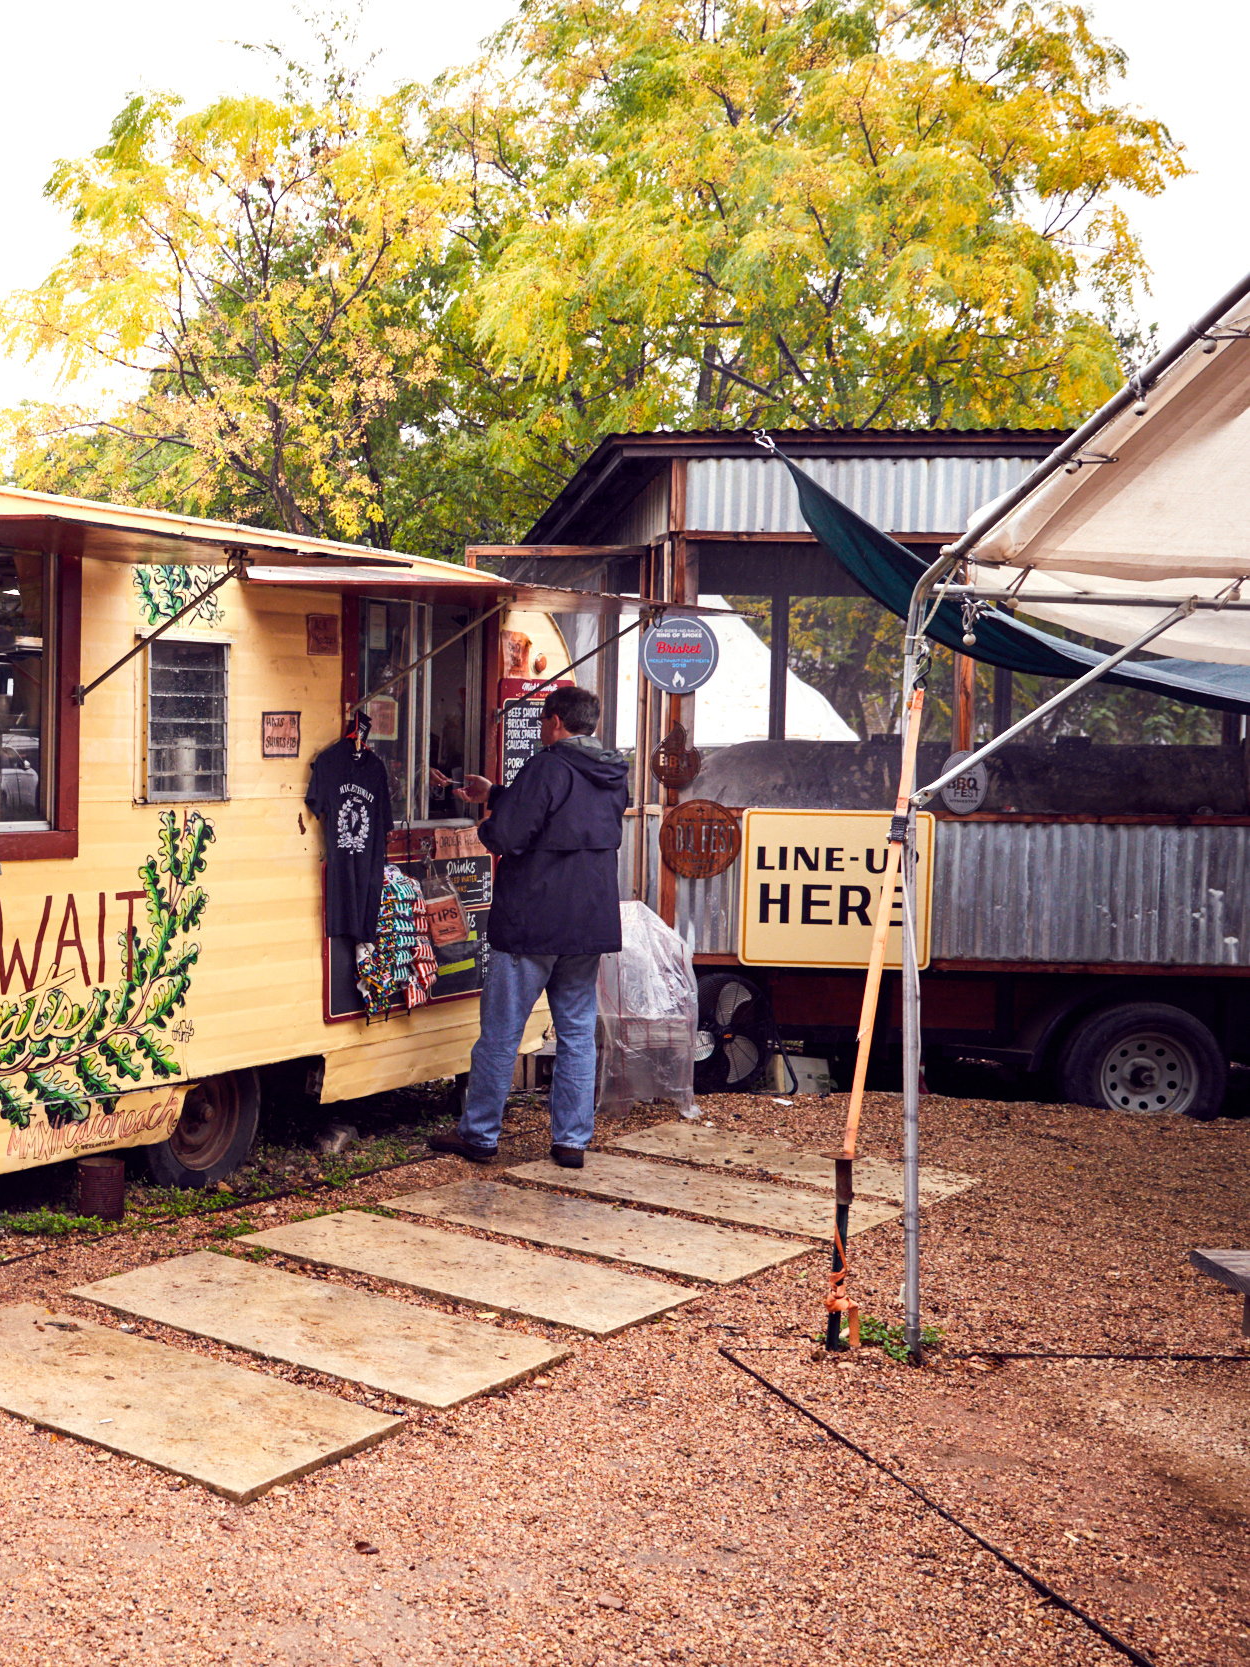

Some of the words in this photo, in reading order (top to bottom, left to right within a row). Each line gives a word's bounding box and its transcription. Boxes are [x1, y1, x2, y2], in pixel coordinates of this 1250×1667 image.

[656, 641, 702, 654] Brisket
[522, 707, 539, 718] SHORT
[266, 716, 285, 728] HATS
[507, 718, 530, 729] BRISKET
[507, 729, 521, 739] PORK
[521, 729, 537, 739] SPARE
[265, 735, 286, 748] SHIRTS
[506, 740, 530, 750] SAUSAGE
[507, 757, 525, 769] PORK
[953, 788, 980, 798] FEST
[439, 835, 462, 849] ORDER
[701, 824, 736, 853] FEST
[756, 845, 920, 875] LINE-U
[446, 859, 476, 876] Drinks
[461, 874, 478, 883] WATER
[429, 907, 458, 924] TIPS
